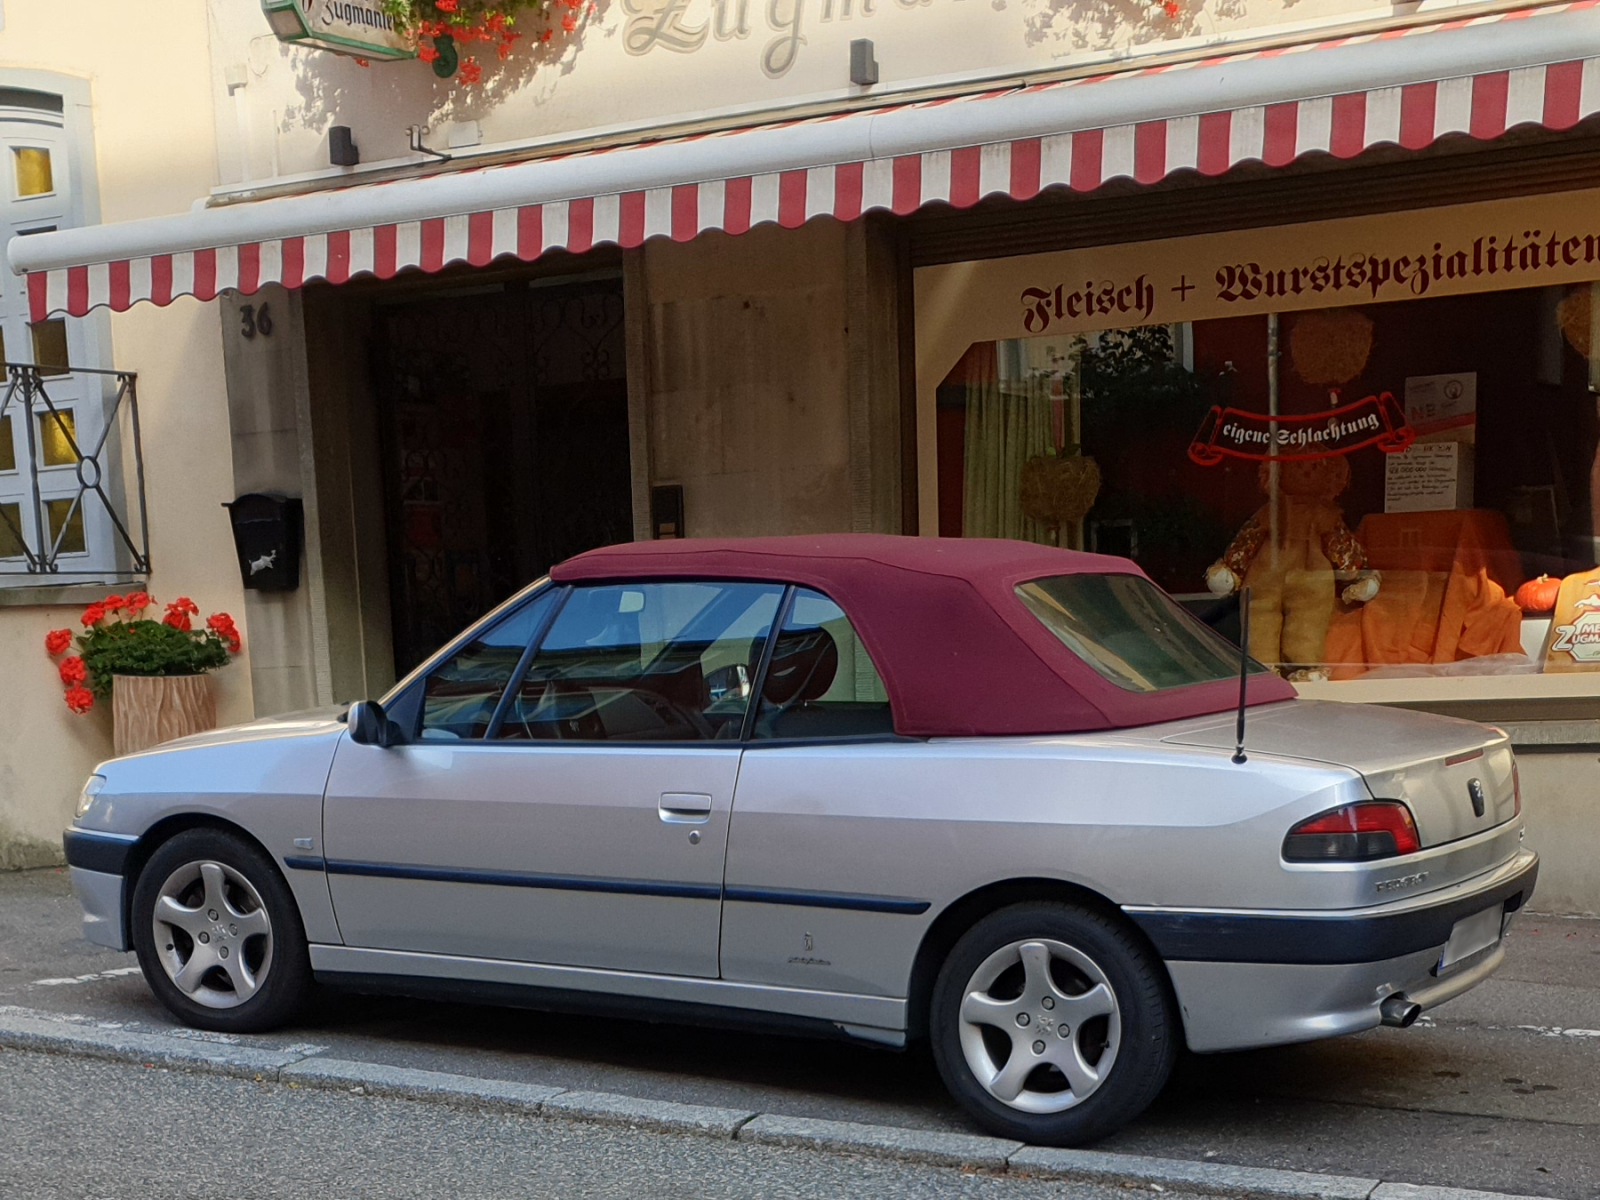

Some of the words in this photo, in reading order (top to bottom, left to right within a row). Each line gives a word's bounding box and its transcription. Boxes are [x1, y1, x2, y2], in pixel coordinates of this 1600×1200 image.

[321, 0, 397, 31] Zugmante
[1020, 274, 1155, 333] Fleisch
[1171, 277, 1196, 302] +
[1215, 230, 1600, 302] Wurstspezialitäten
[240, 302, 273, 339] 36
[1222, 422, 1271, 445] eigene
[1276, 412, 1380, 447] Schlachtung
[1551, 624, 1600, 652] ZUGM
